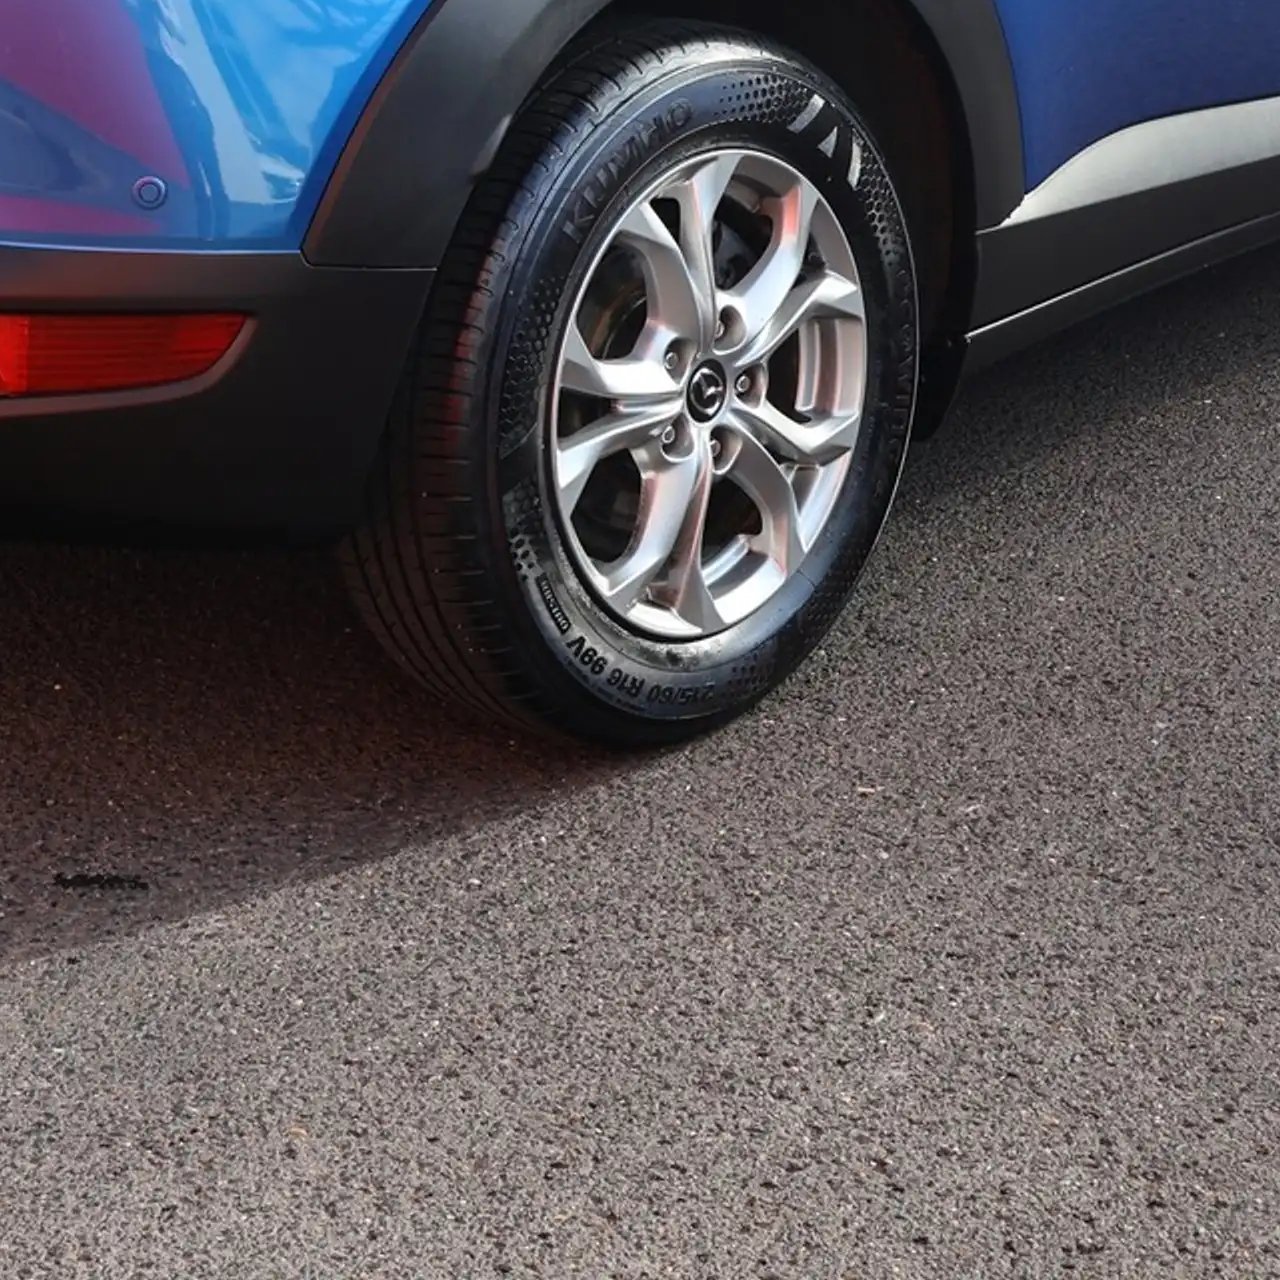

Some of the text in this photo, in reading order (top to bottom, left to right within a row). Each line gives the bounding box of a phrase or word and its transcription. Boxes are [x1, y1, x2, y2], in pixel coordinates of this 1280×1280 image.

[562, 97, 692, 244] KUMHO
[566, 635, 609, 676] 99V
[607, 668, 646, 699] R16
[648, 681, 716, 705] 215/60
